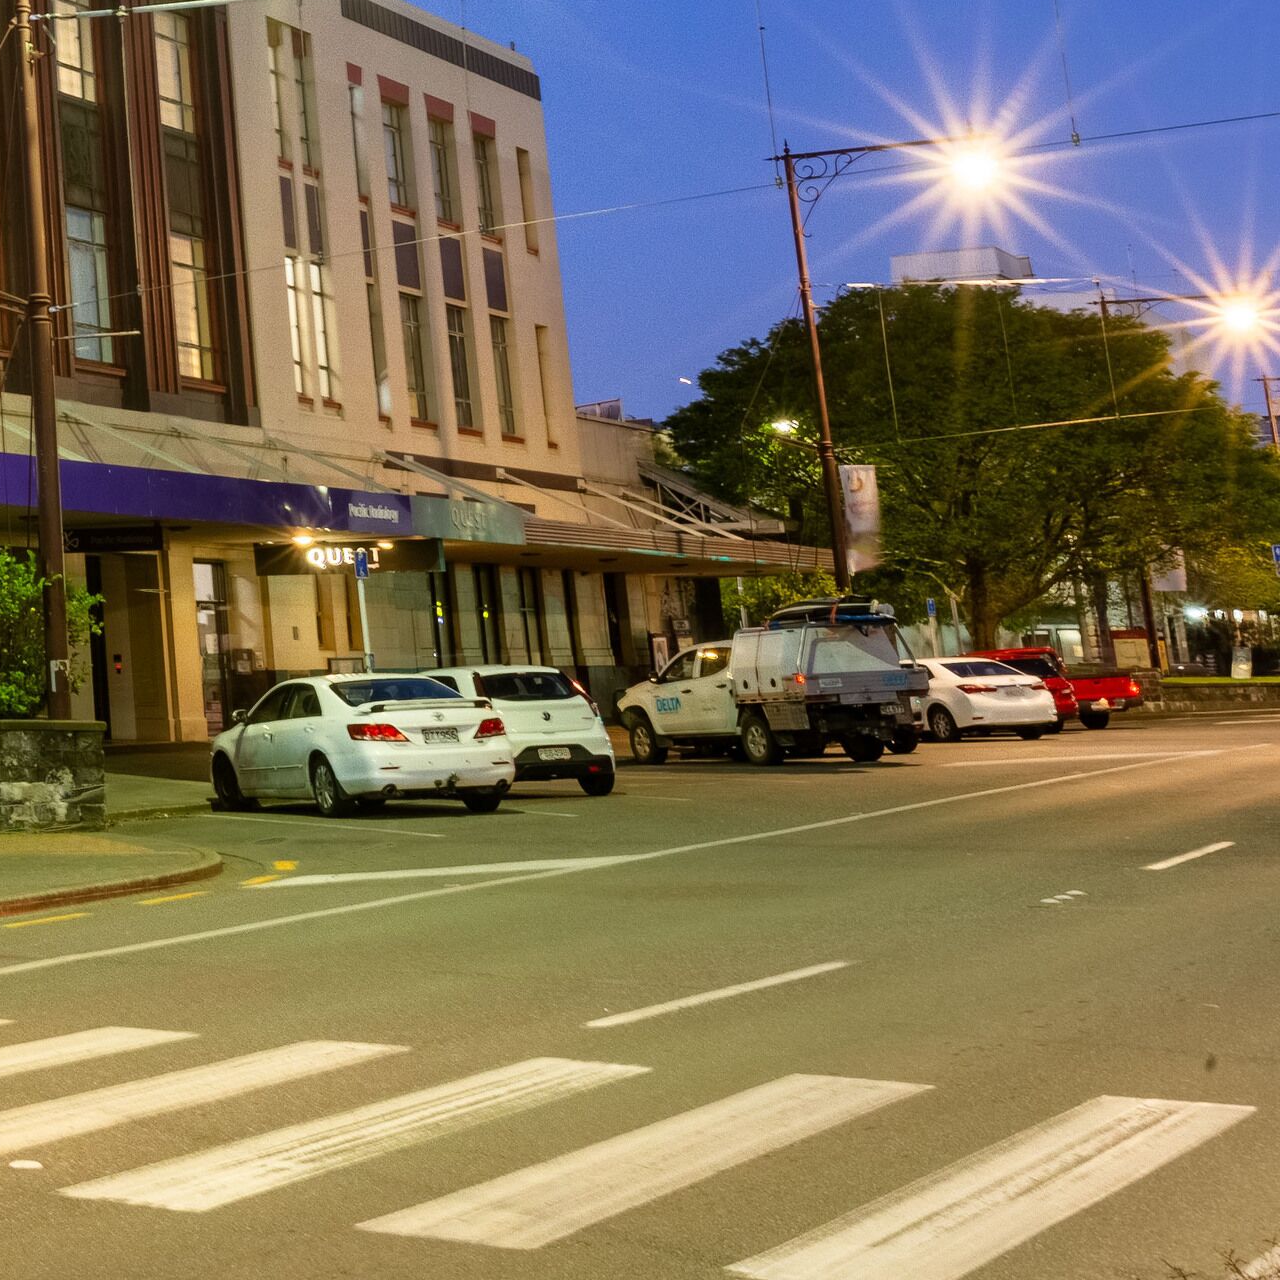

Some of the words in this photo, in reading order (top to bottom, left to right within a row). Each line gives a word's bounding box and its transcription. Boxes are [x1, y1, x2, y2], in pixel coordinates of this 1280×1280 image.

[348, 502, 370, 518] Pacific
[369, 504, 399, 524] Radiology
[306, 547, 380, 570] QUET
[656, 697, 682, 713] DELTA
